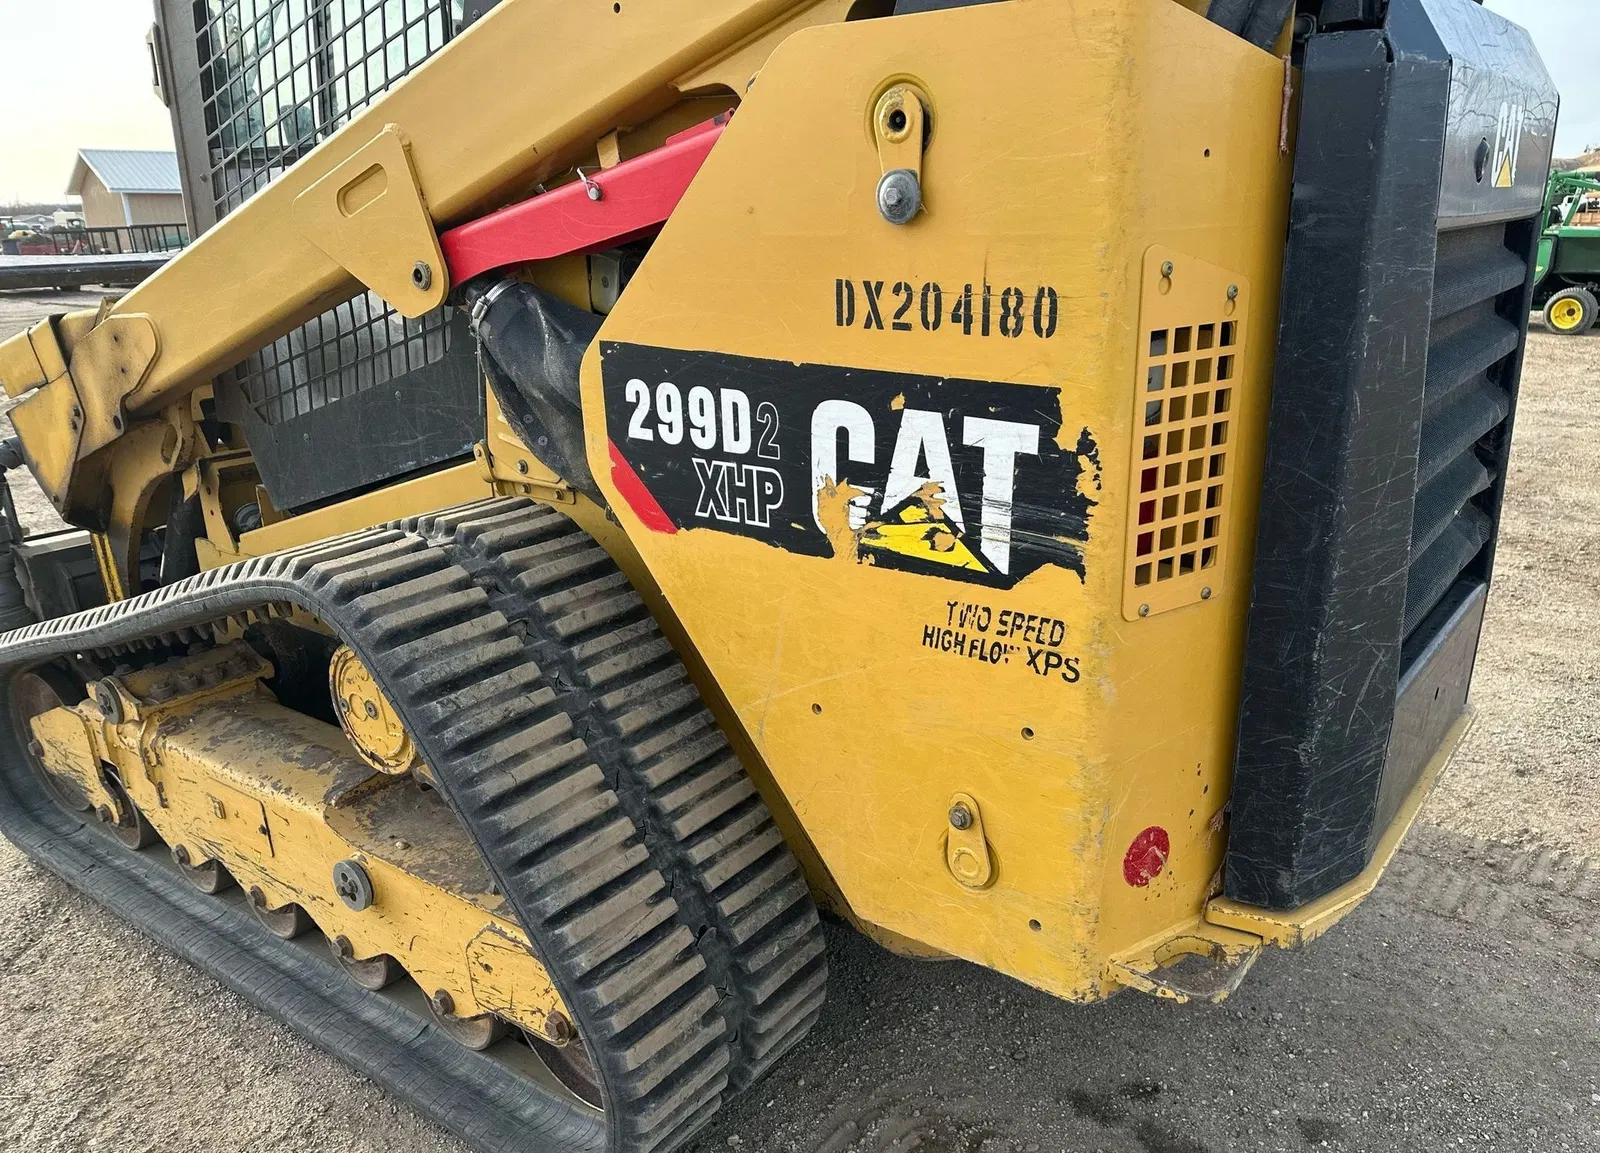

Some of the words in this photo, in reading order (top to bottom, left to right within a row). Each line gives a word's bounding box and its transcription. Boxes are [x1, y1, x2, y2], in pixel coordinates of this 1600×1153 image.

[1491, 102, 1524, 188] CAT
[836, 278, 1058, 339] DX204180
[692, 457, 784, 528] XHP
[811, 399, 1040, 576] CAT
[922, 624, 967, 656] HIGH
[968, 638, 1021, 665] FLO
[1026, 646, 1081, 683] XPS
[947, 601, 992, 632] TWO
[996, 609, 1066, 648] SPEED
